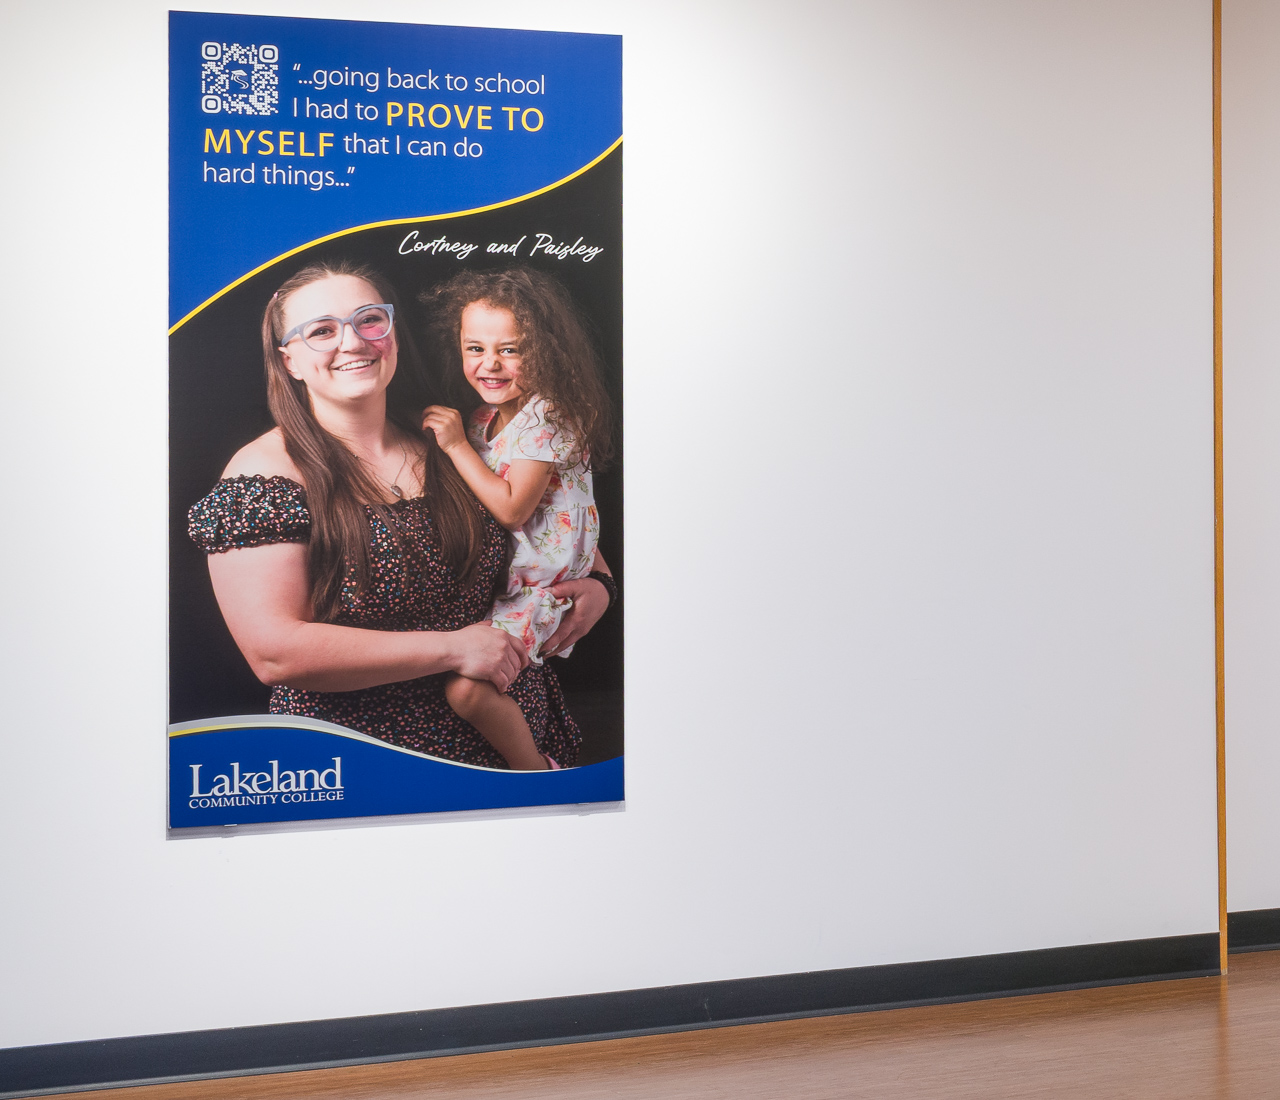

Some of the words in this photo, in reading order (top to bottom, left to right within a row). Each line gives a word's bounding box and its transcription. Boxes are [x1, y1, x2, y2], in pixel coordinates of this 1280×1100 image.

[388, 67, 439, 91] back
[445, 75, 469, 91] to
[474, 74, 546, 95] school
[293, 97, 298, 118] I
[305, 98, 348, 120] had
[355, 104, 379, 121] to
[386, 101, 493, 131] PROVE
[502, 106, 544, 133] TO
[204, 128, 335, 157] MYSELF
[344, 134, 389, 155] that
[395, 136, 400, 154] I
[407, 139, 447, 157] can
[454, 137, 483, 157] do
[203, 161, 255, 184] hard
[398, 230, 478, 260] Cortney
[487, 236, 527, 256] and
[528, 234, 603, 262] Paisley
[189, 757, 344, 798] Lakeland
[189, 794, 278, 809] COMMUNITY
[281, 791, 344, 804] COLLEGE
